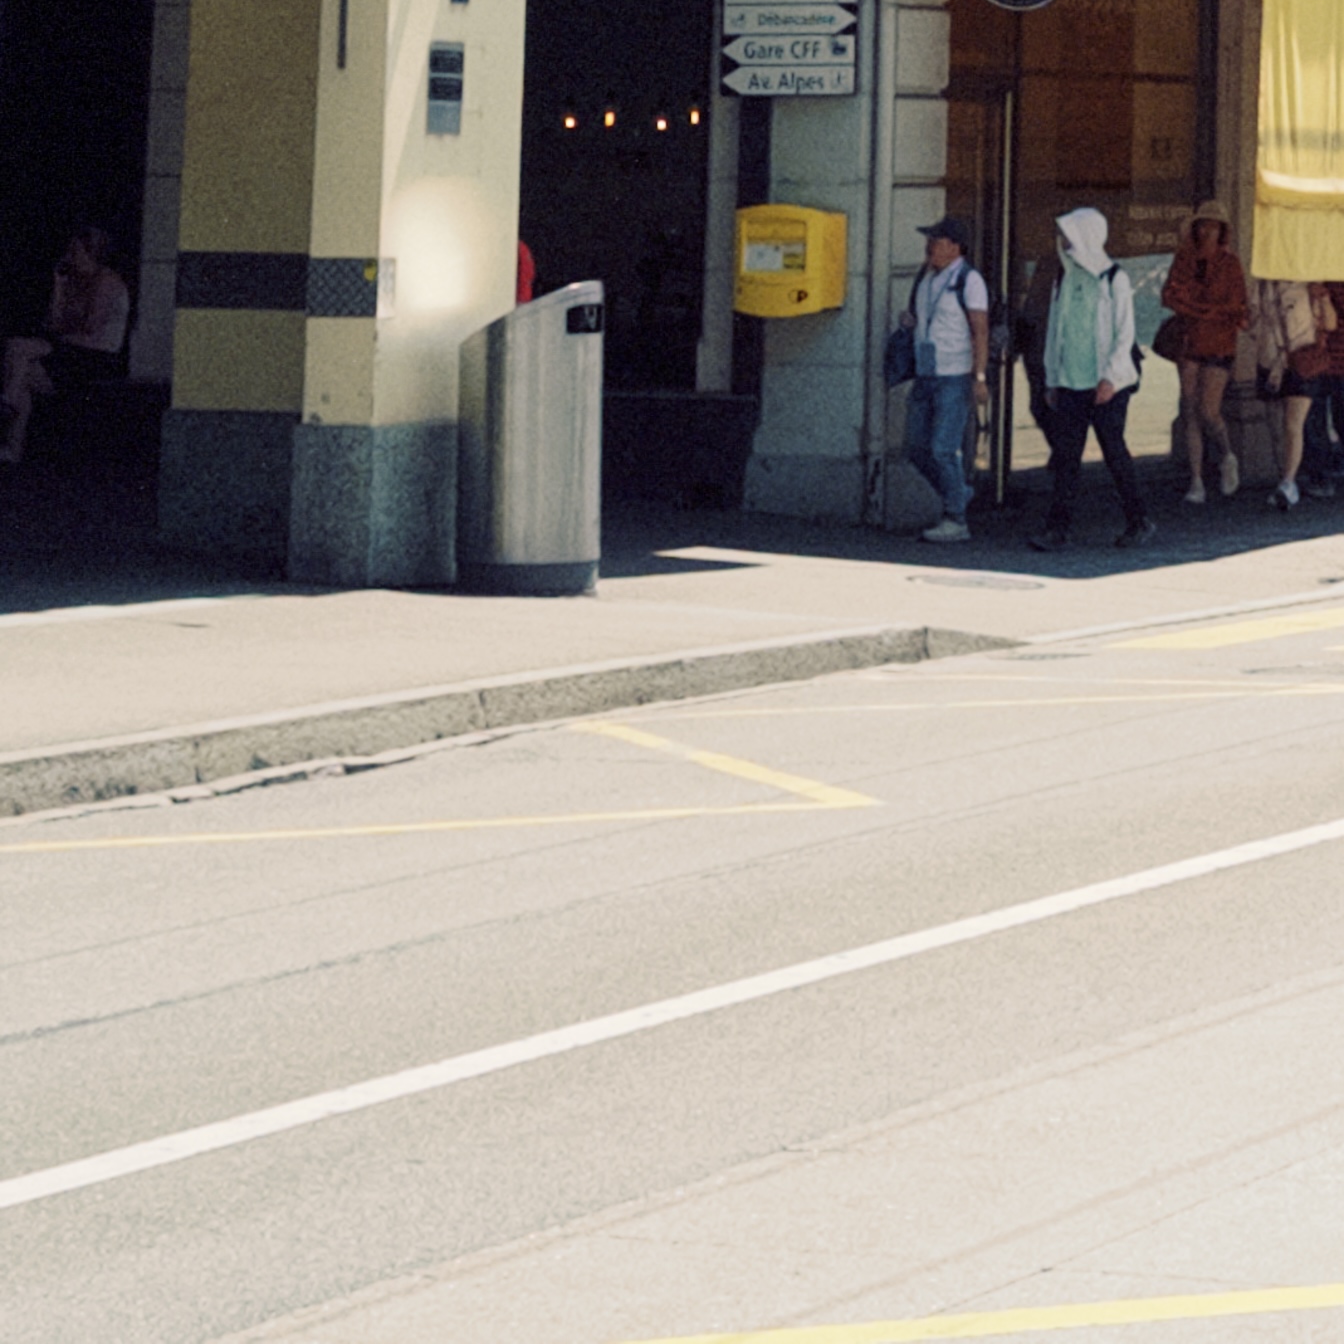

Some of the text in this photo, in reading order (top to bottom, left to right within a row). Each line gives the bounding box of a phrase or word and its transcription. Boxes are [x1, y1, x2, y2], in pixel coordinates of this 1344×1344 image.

[744, 40, 821, 59] Gare CFF
[778, 72, 825, 95] Alpes
